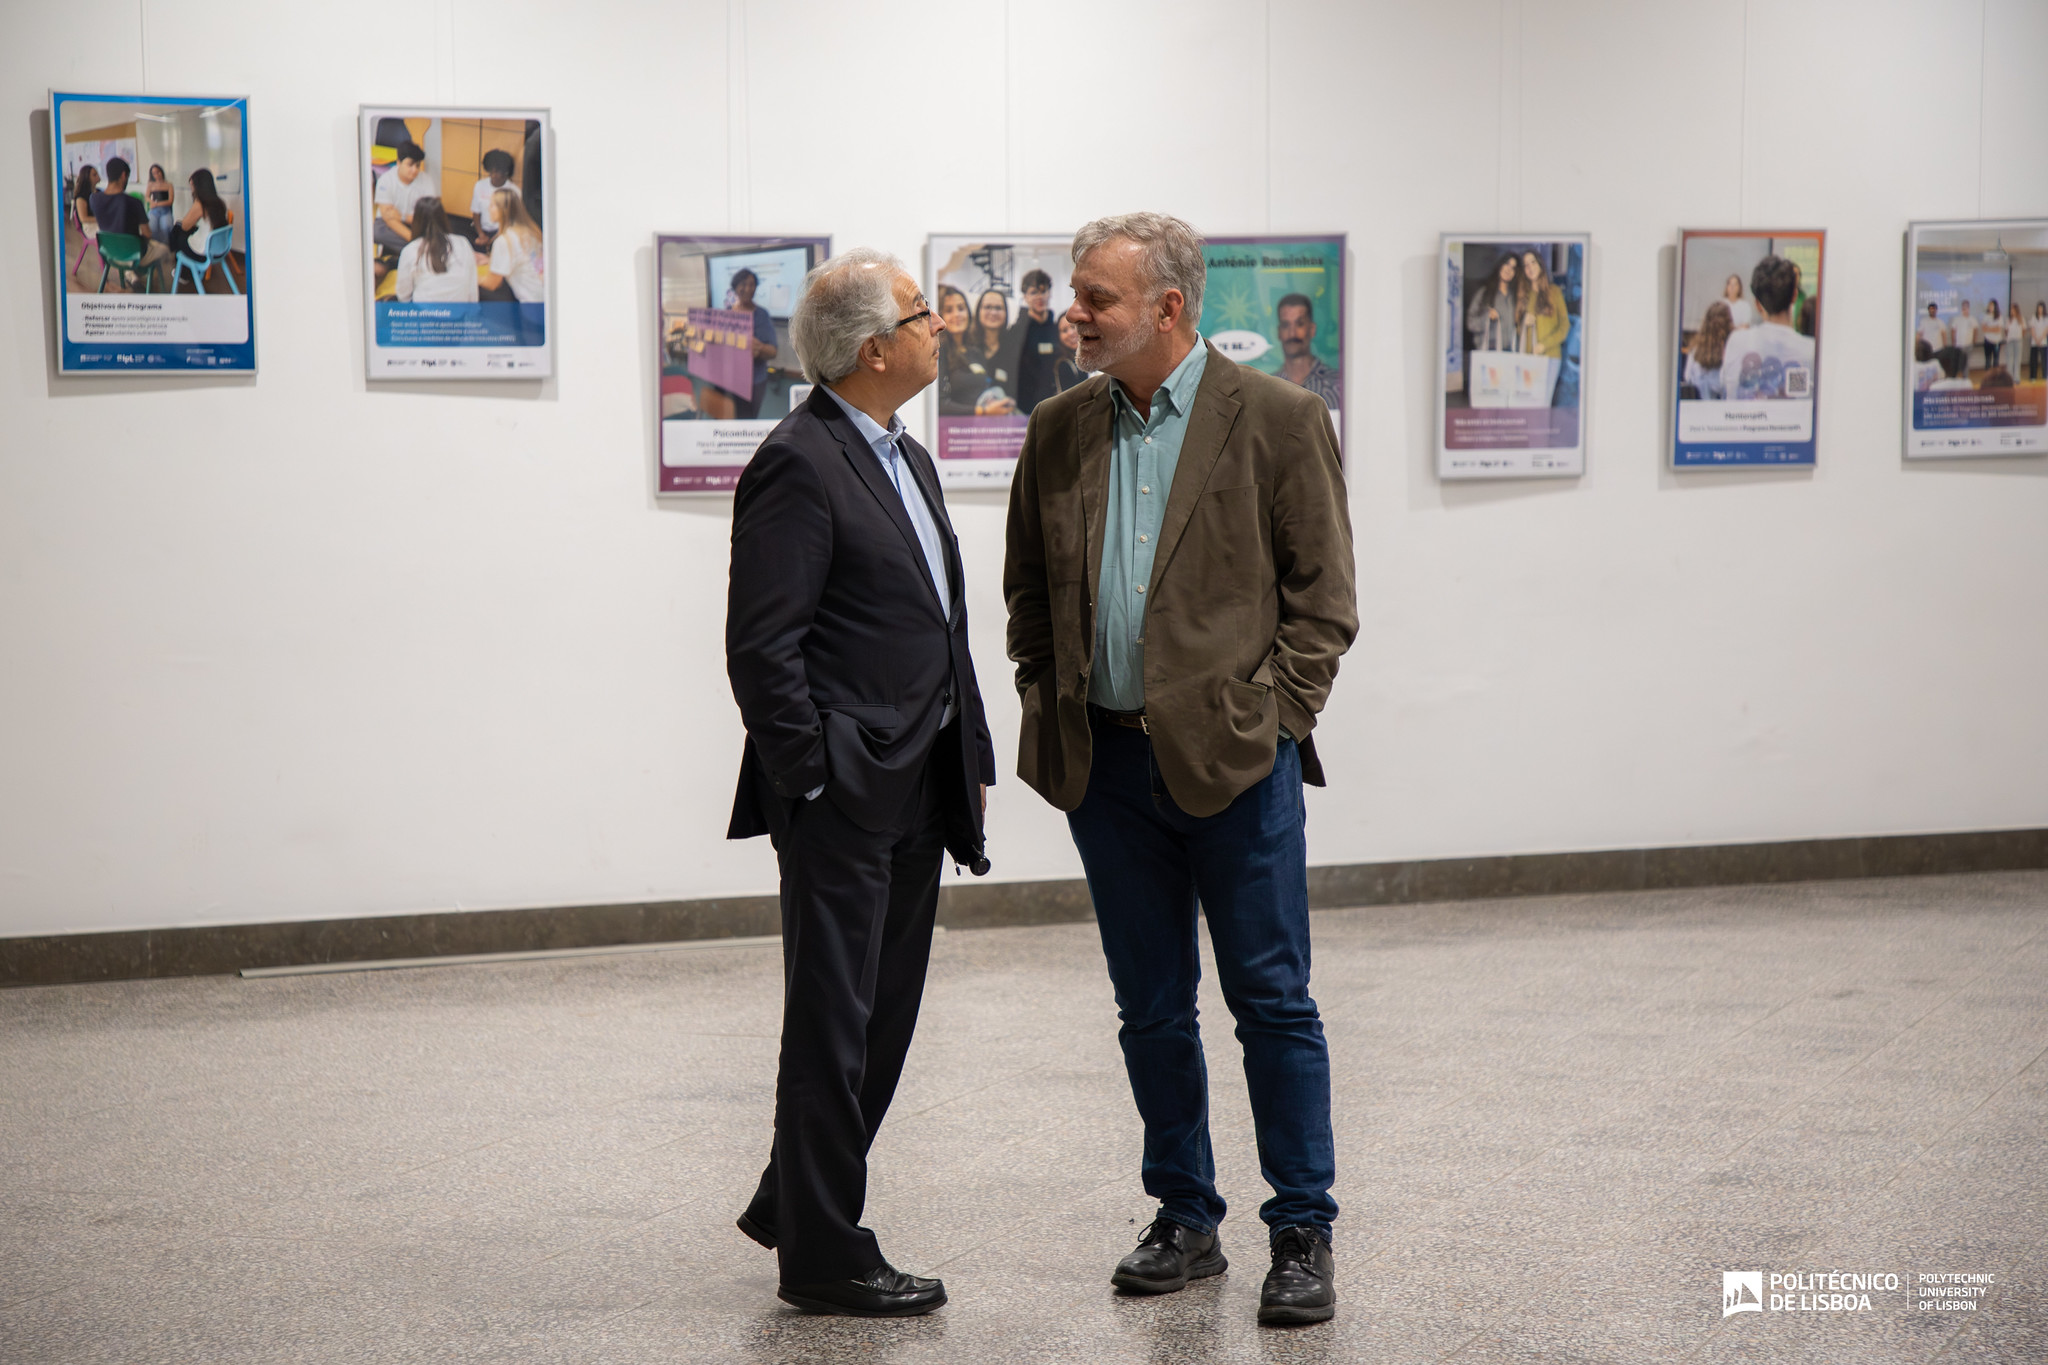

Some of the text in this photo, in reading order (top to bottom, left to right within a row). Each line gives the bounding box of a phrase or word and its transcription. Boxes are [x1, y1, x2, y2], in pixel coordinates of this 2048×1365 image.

[1208, 255, 1257, 268] António
[81, 302, 163, 311] Objetivos do Programa
[388, 308, 408, 318] Áreas
[408, 309, 418, 318] de
